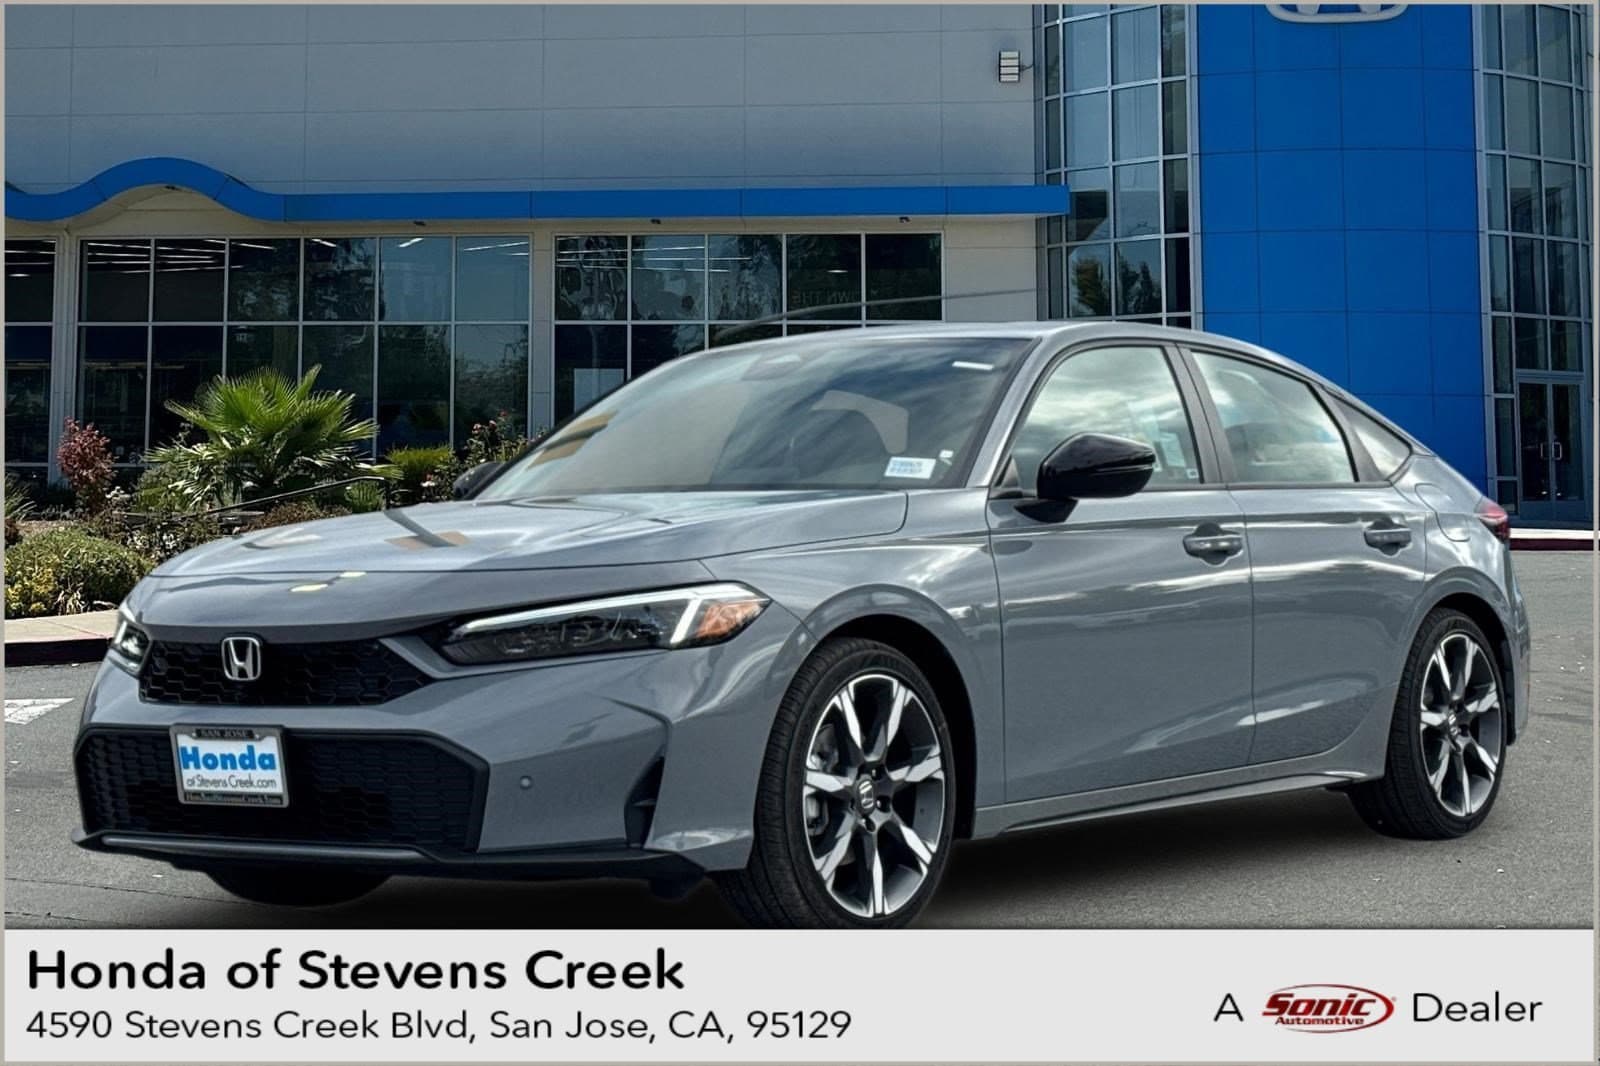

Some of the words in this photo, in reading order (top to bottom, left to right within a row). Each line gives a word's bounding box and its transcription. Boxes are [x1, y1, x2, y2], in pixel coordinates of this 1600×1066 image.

[200, 729, 221, 737] SAN
[223, 729, 248, 738] JOSE
[179, 744, 277, 771] Honda
